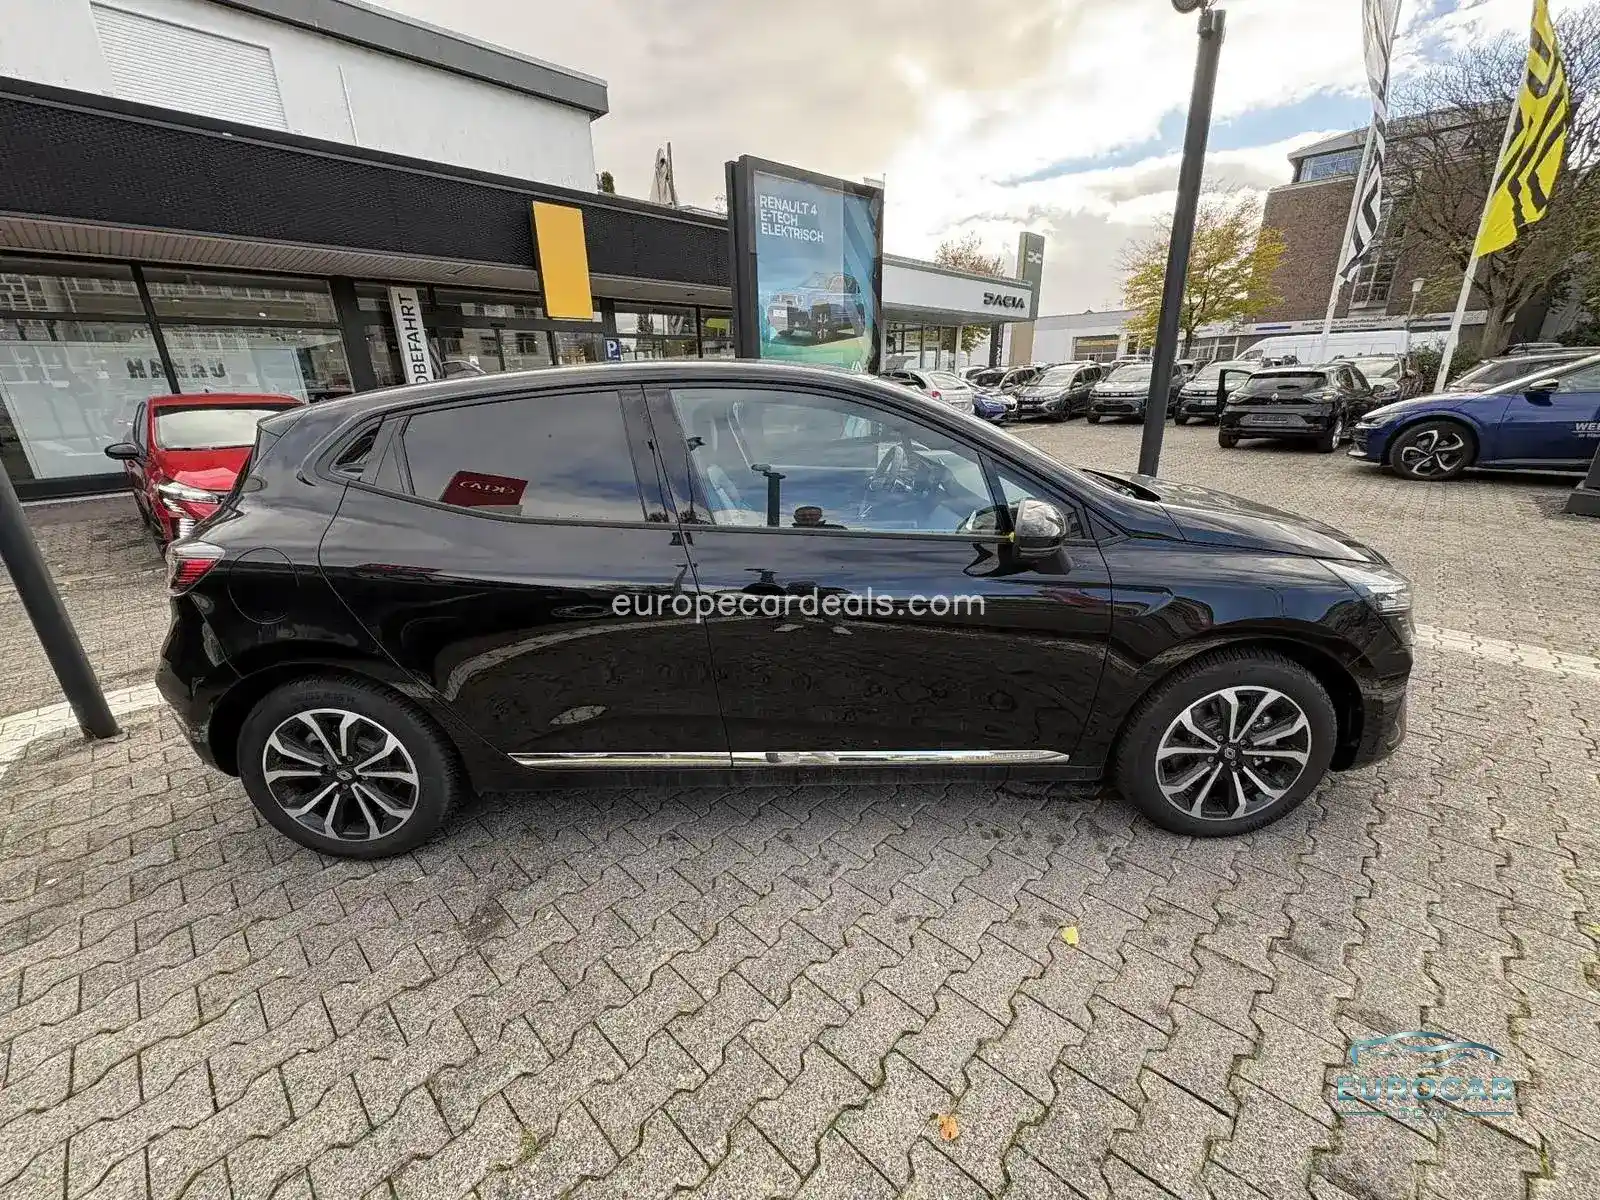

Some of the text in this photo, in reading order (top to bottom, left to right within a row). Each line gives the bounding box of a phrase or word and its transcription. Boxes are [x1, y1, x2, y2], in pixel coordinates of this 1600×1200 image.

[760, 194, 818, 215] RENAULT 4
[760, 208, 798, 227] E-TECH
[761, 222, 824, 243] ELEKTRISCH
[983, 292, 1026, 309] DACIA
[606, 340, 618, 358] P
